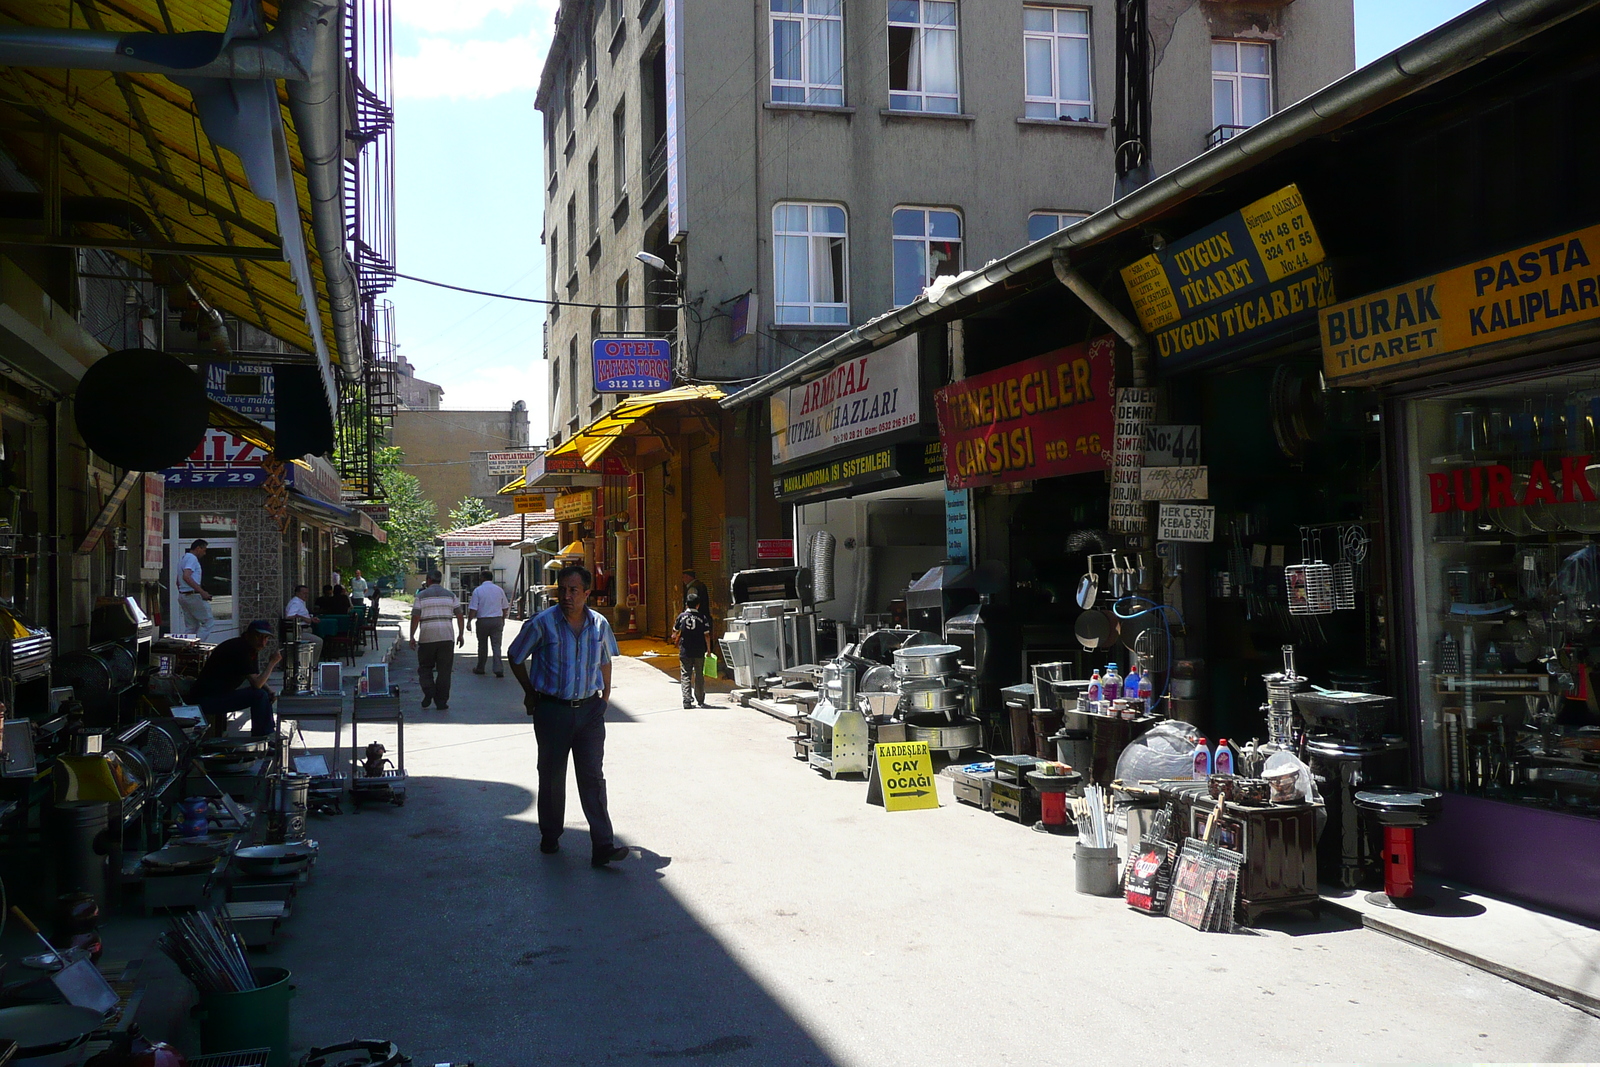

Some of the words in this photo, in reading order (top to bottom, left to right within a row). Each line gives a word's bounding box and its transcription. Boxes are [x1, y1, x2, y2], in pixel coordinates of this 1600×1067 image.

[1259, 229, 1276, 245] 311
[1276, 222, 1290, 237] 48
[1291, 215, 1305, 230] 67
[1174, 231, 1235, 276] UYGUN
[1265, 243, 1284, 261] 324
[1285, 238, 1296, 252] 17
[1298, 231, 1313, 246] 55
[1473, 237, 1591, 298] PASTA
[1180, 257, 1255, 309] TİCARET
[1156, 313, 1221, 358] UYGUN
[1222, 276, 1320, 340] TİCARET
[1327, 283, 1441, 347] BURAK
[605, 341, 660, 356] OTEL
[1336, 327, 1438, 369] TİCARET
[238, 365, 275, 376] MEŞHU
[597, 359, 636, 383] KAFKAS
[637, 358, 670, 382] TOROS
[608, 380, 628, 389] 312
[632, 379, 645, 388] 12
[648, 379, 661, 388] 16
[800, 358, 870, 416] ARMETAL
[235, 396, 246, 404] ve
[948, 357, 1095, 431] TENEKECİLER
[824, 388, 898, 434] CİHAZLARI
[1118, 406, 1152, 420] DEMİR
[878, 420, 892, 434] 0532
[1117, 420, 1146, 436] DÖKÜ
[954, 425, 1036, 483] ÇARŞISI
[1074, 432, 1102, 456] 46
[842, 449, 892, 479] SİSTEMLERİ
[163, 474, 182, 484] 4
[191, 473, 219, 483] 57
[227, 473, 256, 483] 29
[1113, 469, 1142, 484] SİLVE
[1147, 469, 1172, 482] HER
[1161, 480, 1194, 491] KOVA
[1426, 454, 1599, 514] BURAK
[1143, 489, 1197, 500] BULUNUR
[1161, 507, 1181, 518] HER
[1160, 518, 1192, 529] KEBAB
[1163, 528, 1210, 540] BULUNUR
[879, 744, 928, 758] KARDEŞLER
[892, 760, 919, 776] ÇAY
[886, 773, 932, 790] OCAĞI
